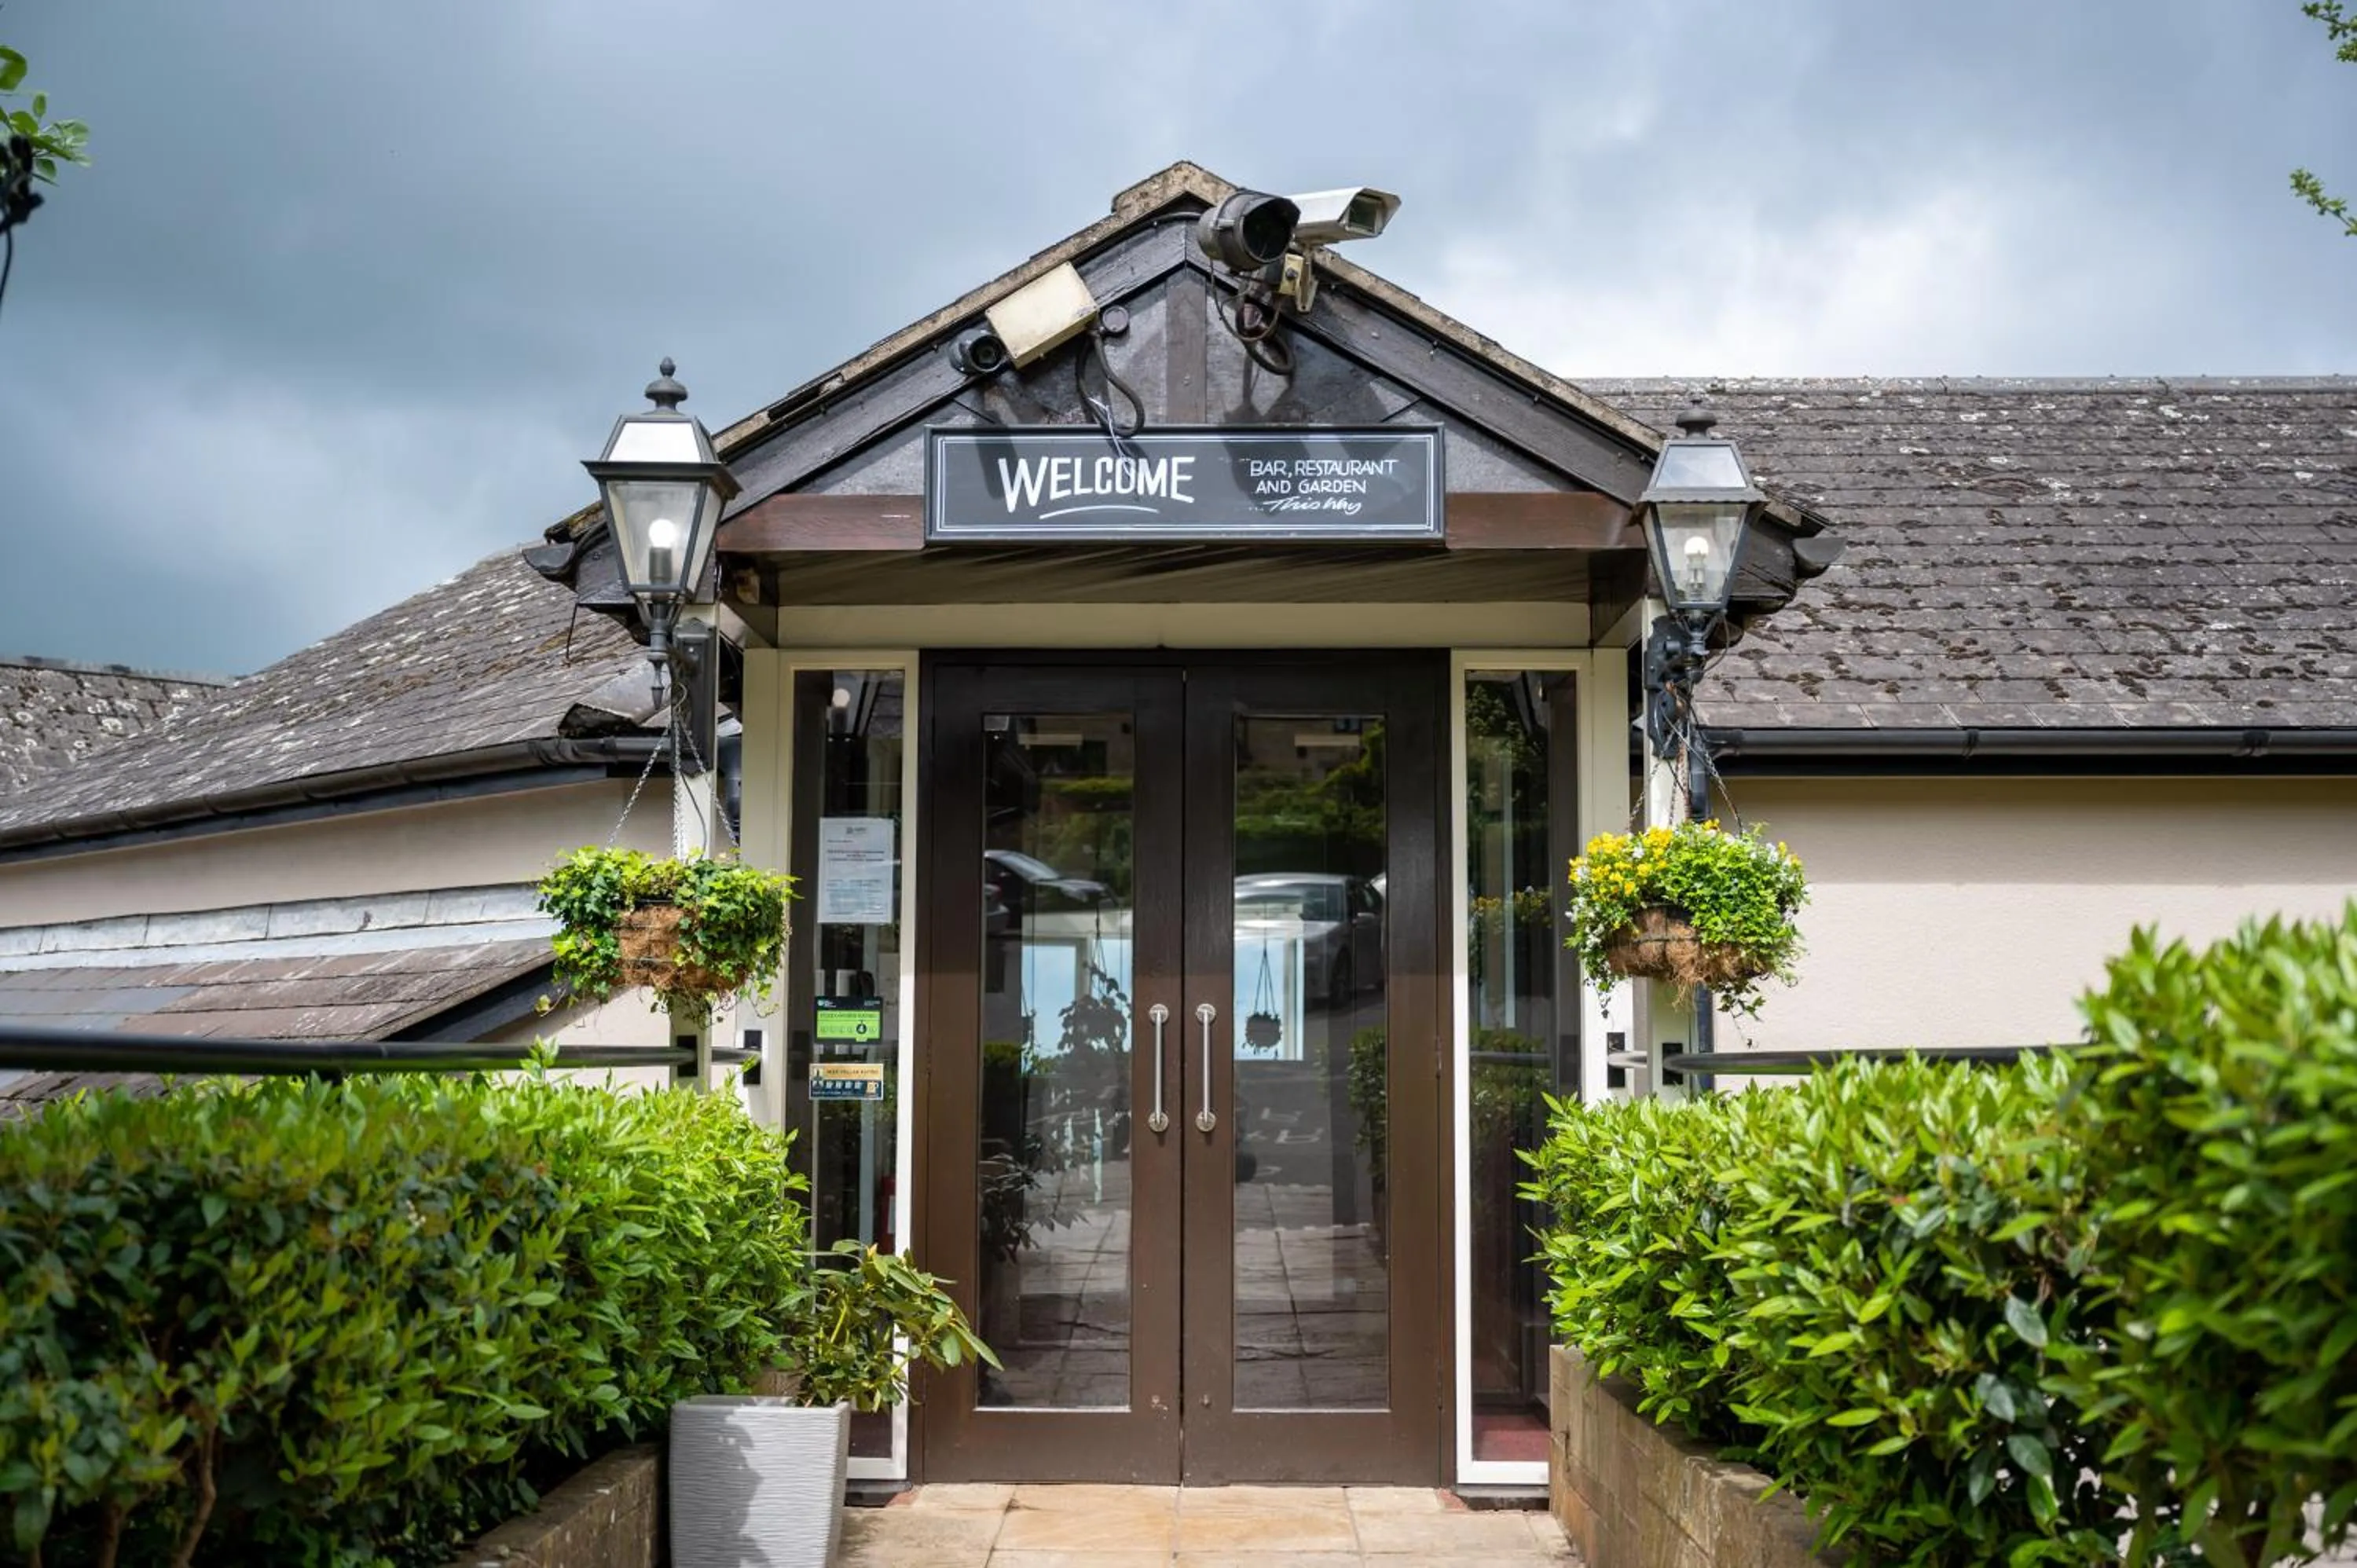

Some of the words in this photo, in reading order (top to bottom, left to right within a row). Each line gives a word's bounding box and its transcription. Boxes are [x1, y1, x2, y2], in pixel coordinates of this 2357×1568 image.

[1249, 460, 1292, 478] BAR,
[1295, 459, 1399, 477] RESTAURANT
[997, 456, 1196, 513] WELCOME
[1255, 479, 1292, 494] AND
[1298, 478, 1367, 494] GARDEN
[1263, 496, 1321, 513] This
[1321, 496, 1362, 515] Way
